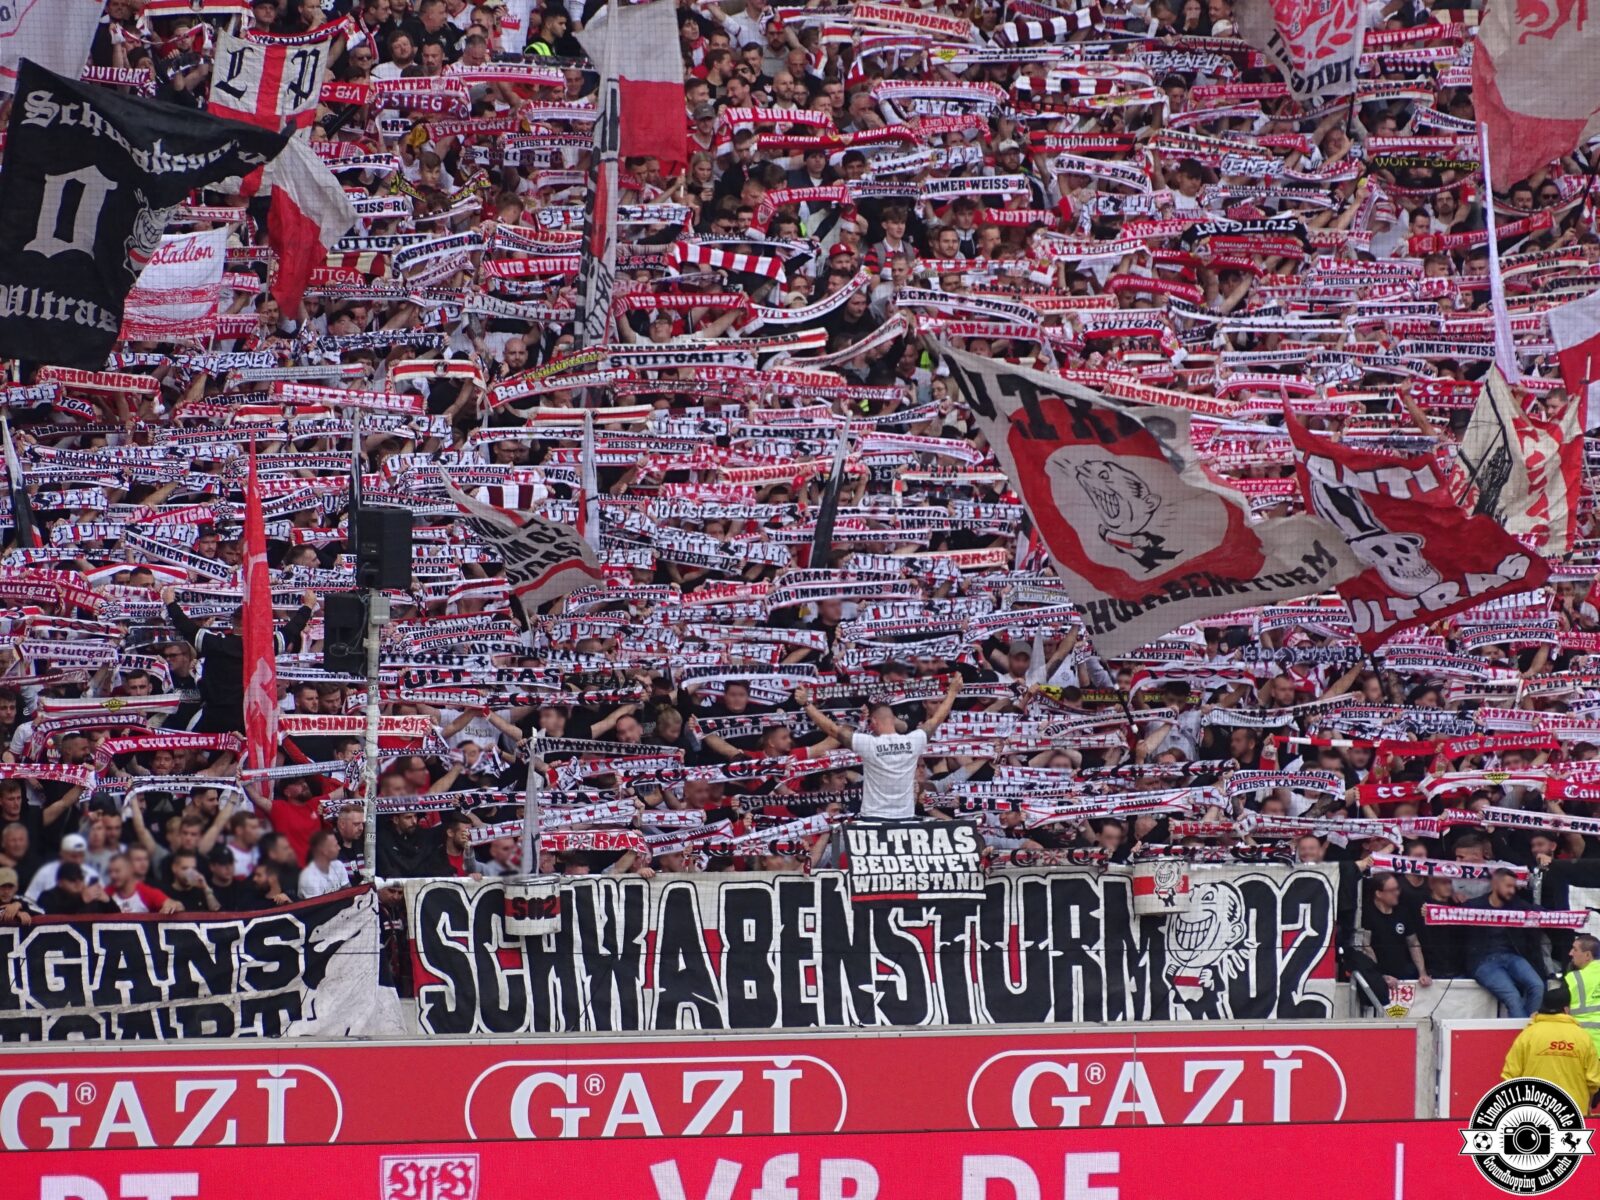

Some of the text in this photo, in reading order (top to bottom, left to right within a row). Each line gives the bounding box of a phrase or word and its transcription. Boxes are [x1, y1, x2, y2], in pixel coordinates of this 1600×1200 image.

[83, 65, 150, 84] STUTTGART
[756, 107, 826, 121] STUTTGART
[436, 121, 513, 136] STUTTGART
[761, 134, 786, 143] MEIN
[858, 128, 893, 138] MEINE
[1046, 135, 1118, 148] Highlander
[972, 179, 1009, 190] WEISS
[1197, 220, 1298, 236] STUTTGART
[150, 237, 213, 264] stadion
[660, 295, 741, 307] STUTTGART
[610, 352, 724, 367] STUTTGART
[494, 369, 628, 400] Bad Cannstatt
[1143, 389, 1180, 405] SIND
[178, 435, 215, 445] HEISST
[256, 460, 291, 471] HEISST
[473, 466, 511, 475] TRAGEN
[901, 520, 989, 529] IMMER WEISS
[301, 529, 338, 539] Bad
[851, 532, 890, 540] WEISS
[143, 540, 228, 578] IMMER WEISS
[796, 588, 838, 599] IMMER
[843, 585, 882, 595] WEISS
[1350, 554, 1531, 633] ULTRAS
[867, 619, 929, 629] BRUSTRING
[414, 623, 511, 639] BRUSTRING TRAGEN
[22, 643, 48, 655] VfB
[421, 638, 455, 649] HEISST
[1559, 639, 1597, 649] MEISTER
[1395, 657, 1430, 667] HEISST
[1547, 681, 1568, 691] DER
[1341, 710, 1375, 719] HEISST
[280, 717, 310, 731] WIR
[317, 717, 356, 730] SIND
[142, 736, 215, 748] STUTTGART
[877, 742, 912, 752] ULTRAS
[1236, 781, 1272, 791] HEISST
[1483, 811, 1542, 826] NECKAR
[847, 826, 977, 852] ULTRAS
[851, 854, 980, 874] BEDEUTET
[852, 873, 985, 893] WIDERSTAND
[1430, 907, 1526, 922] CANNSTATTER
[1550, 1041, 1575, 1050] SDS
